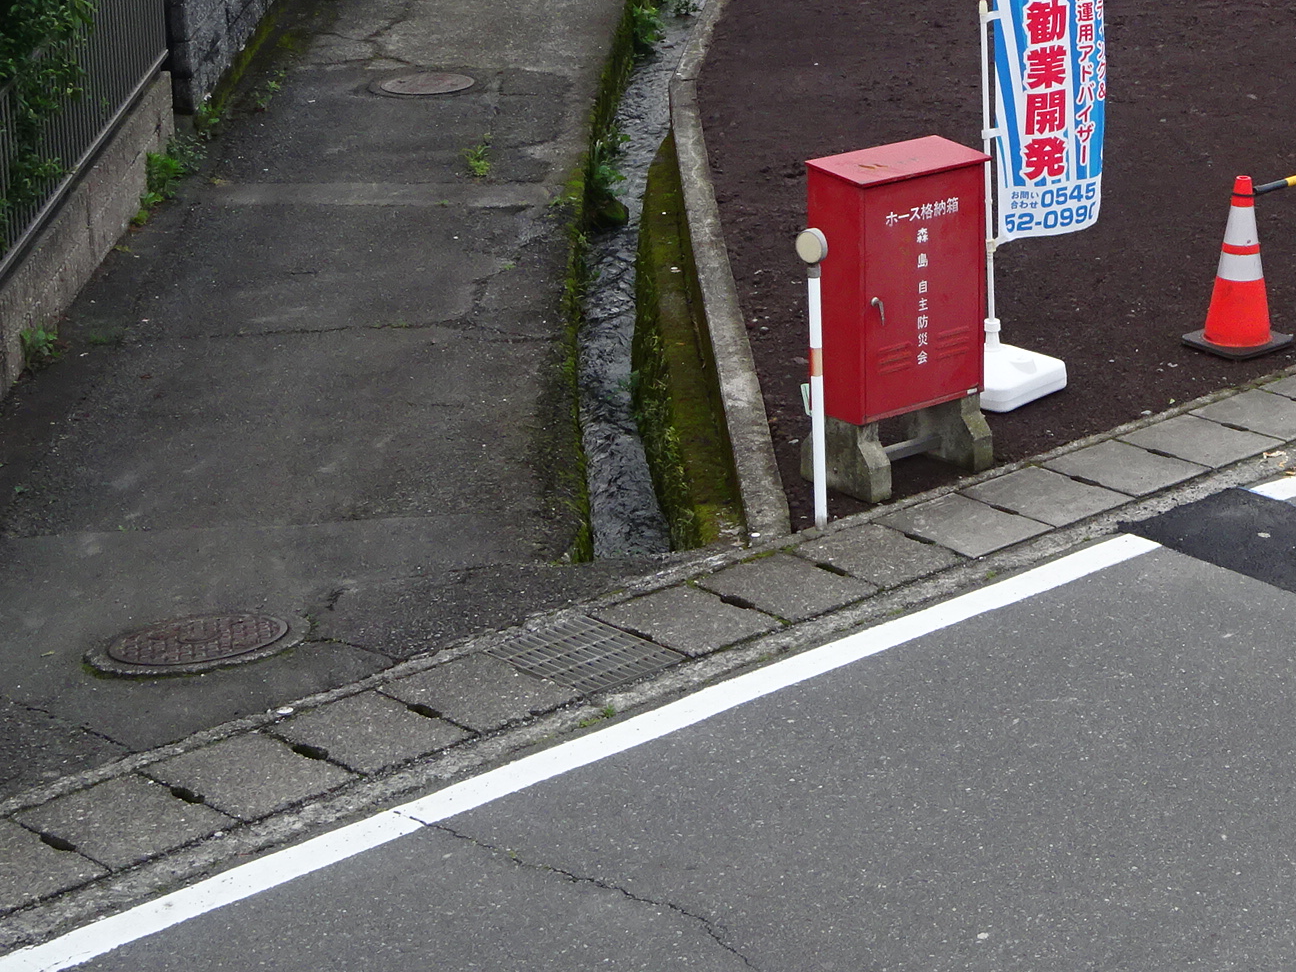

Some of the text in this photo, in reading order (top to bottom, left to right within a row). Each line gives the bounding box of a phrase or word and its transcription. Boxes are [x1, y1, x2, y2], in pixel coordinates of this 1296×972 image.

[1011, 190, 1039, 200] お問い
[1041, 181, 1096, 208] 0545
[885, 196, 959, 227] ホース格納箱
[1010, 200, 1039, 210] 合わせ
